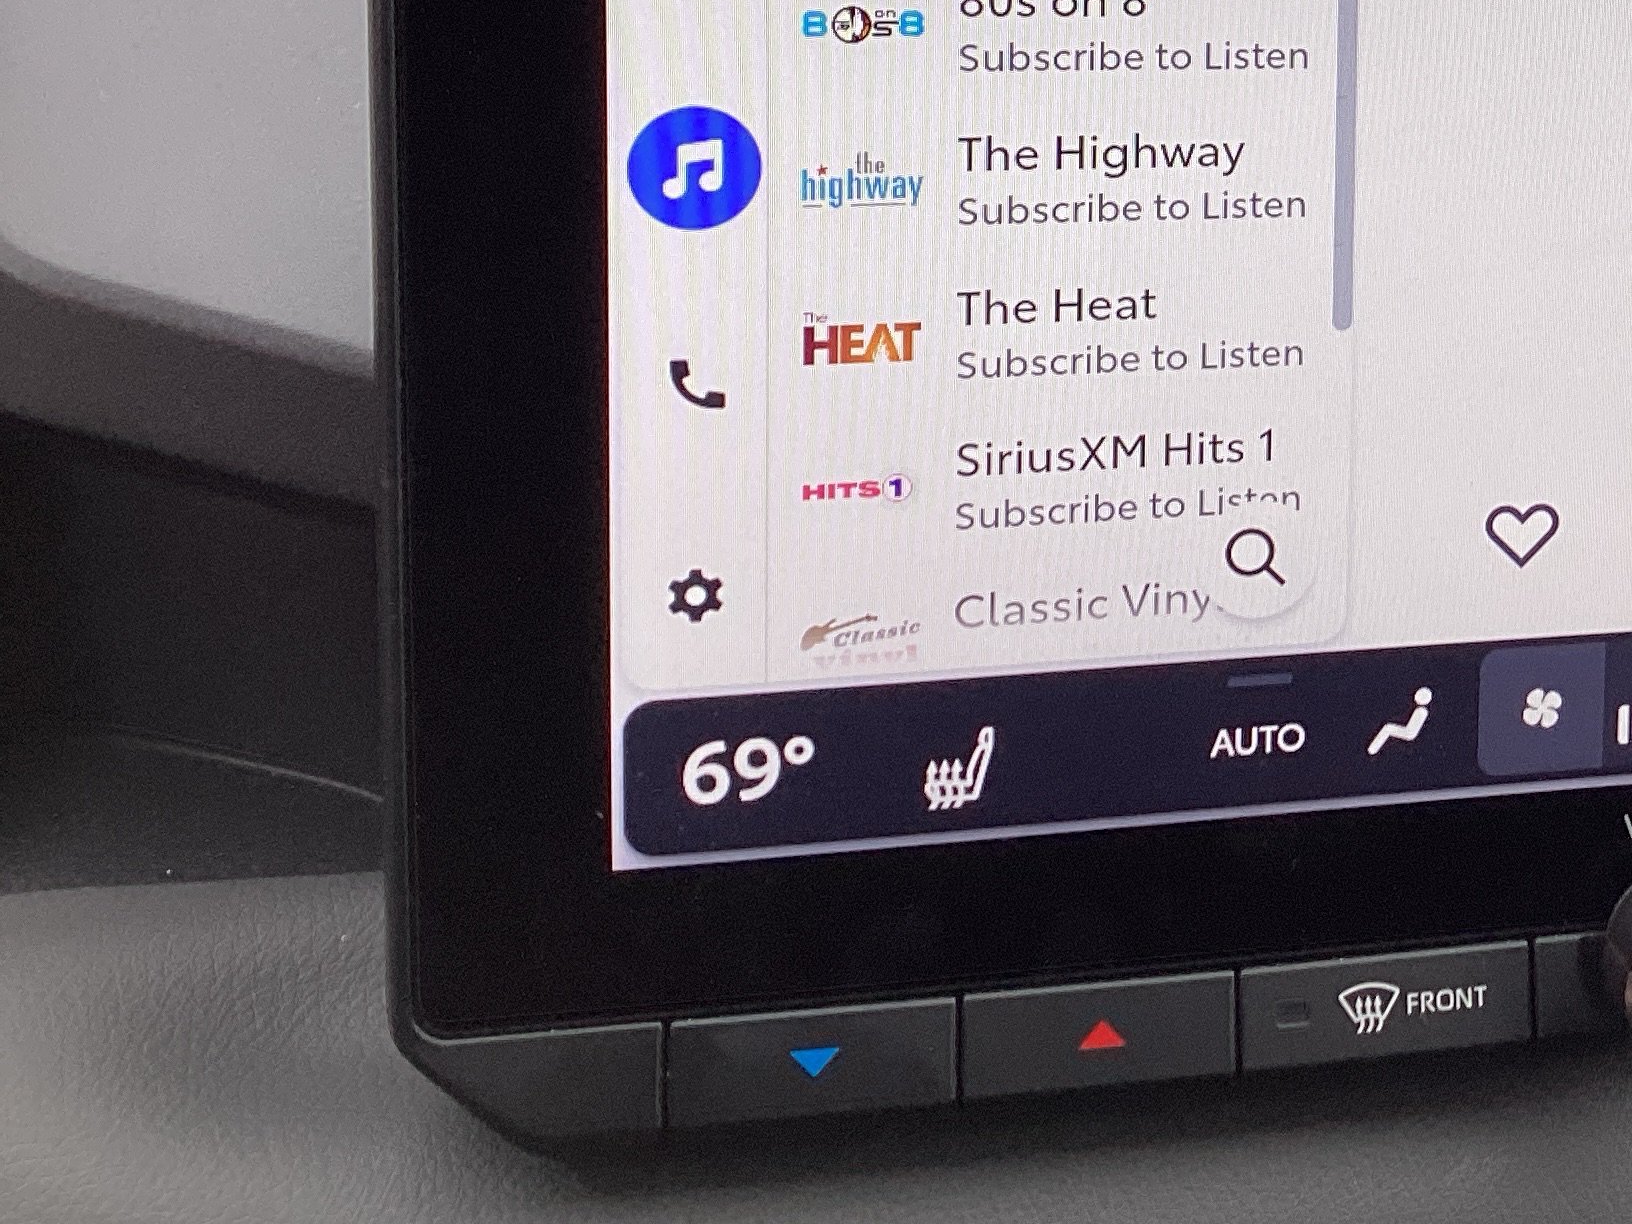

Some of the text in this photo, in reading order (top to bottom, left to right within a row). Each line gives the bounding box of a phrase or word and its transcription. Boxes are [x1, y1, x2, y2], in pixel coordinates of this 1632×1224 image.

[960, 41, 1308, 72] Subscribe to Listen
[856, 151, 885, 174] the
[958, 133, 1244, 178] The Highway
[801, 166, 924, 208] highway
[959, 191, 1305, 225] Subscribe to Listen
[957, 288, 1156, 325] The Heat
[803, 322, 921, 365] HEAT
[958, 341, 1303, 379] Subscribe to Listen
[958, 429, 1272, 476] SiriusXM Hits 1
[801, 478, 903, 501] HITS 1
[956, 494, 1137, 530] Subscribe
[1150, 493, 1185, 518] to
[955, 583, 1224, 627] Classic Viny
[833, 619, 922, 648] Classic
[1211, 724, 1305, 758] AUTO
[1407, 986, 1486, 1014] FRONT
